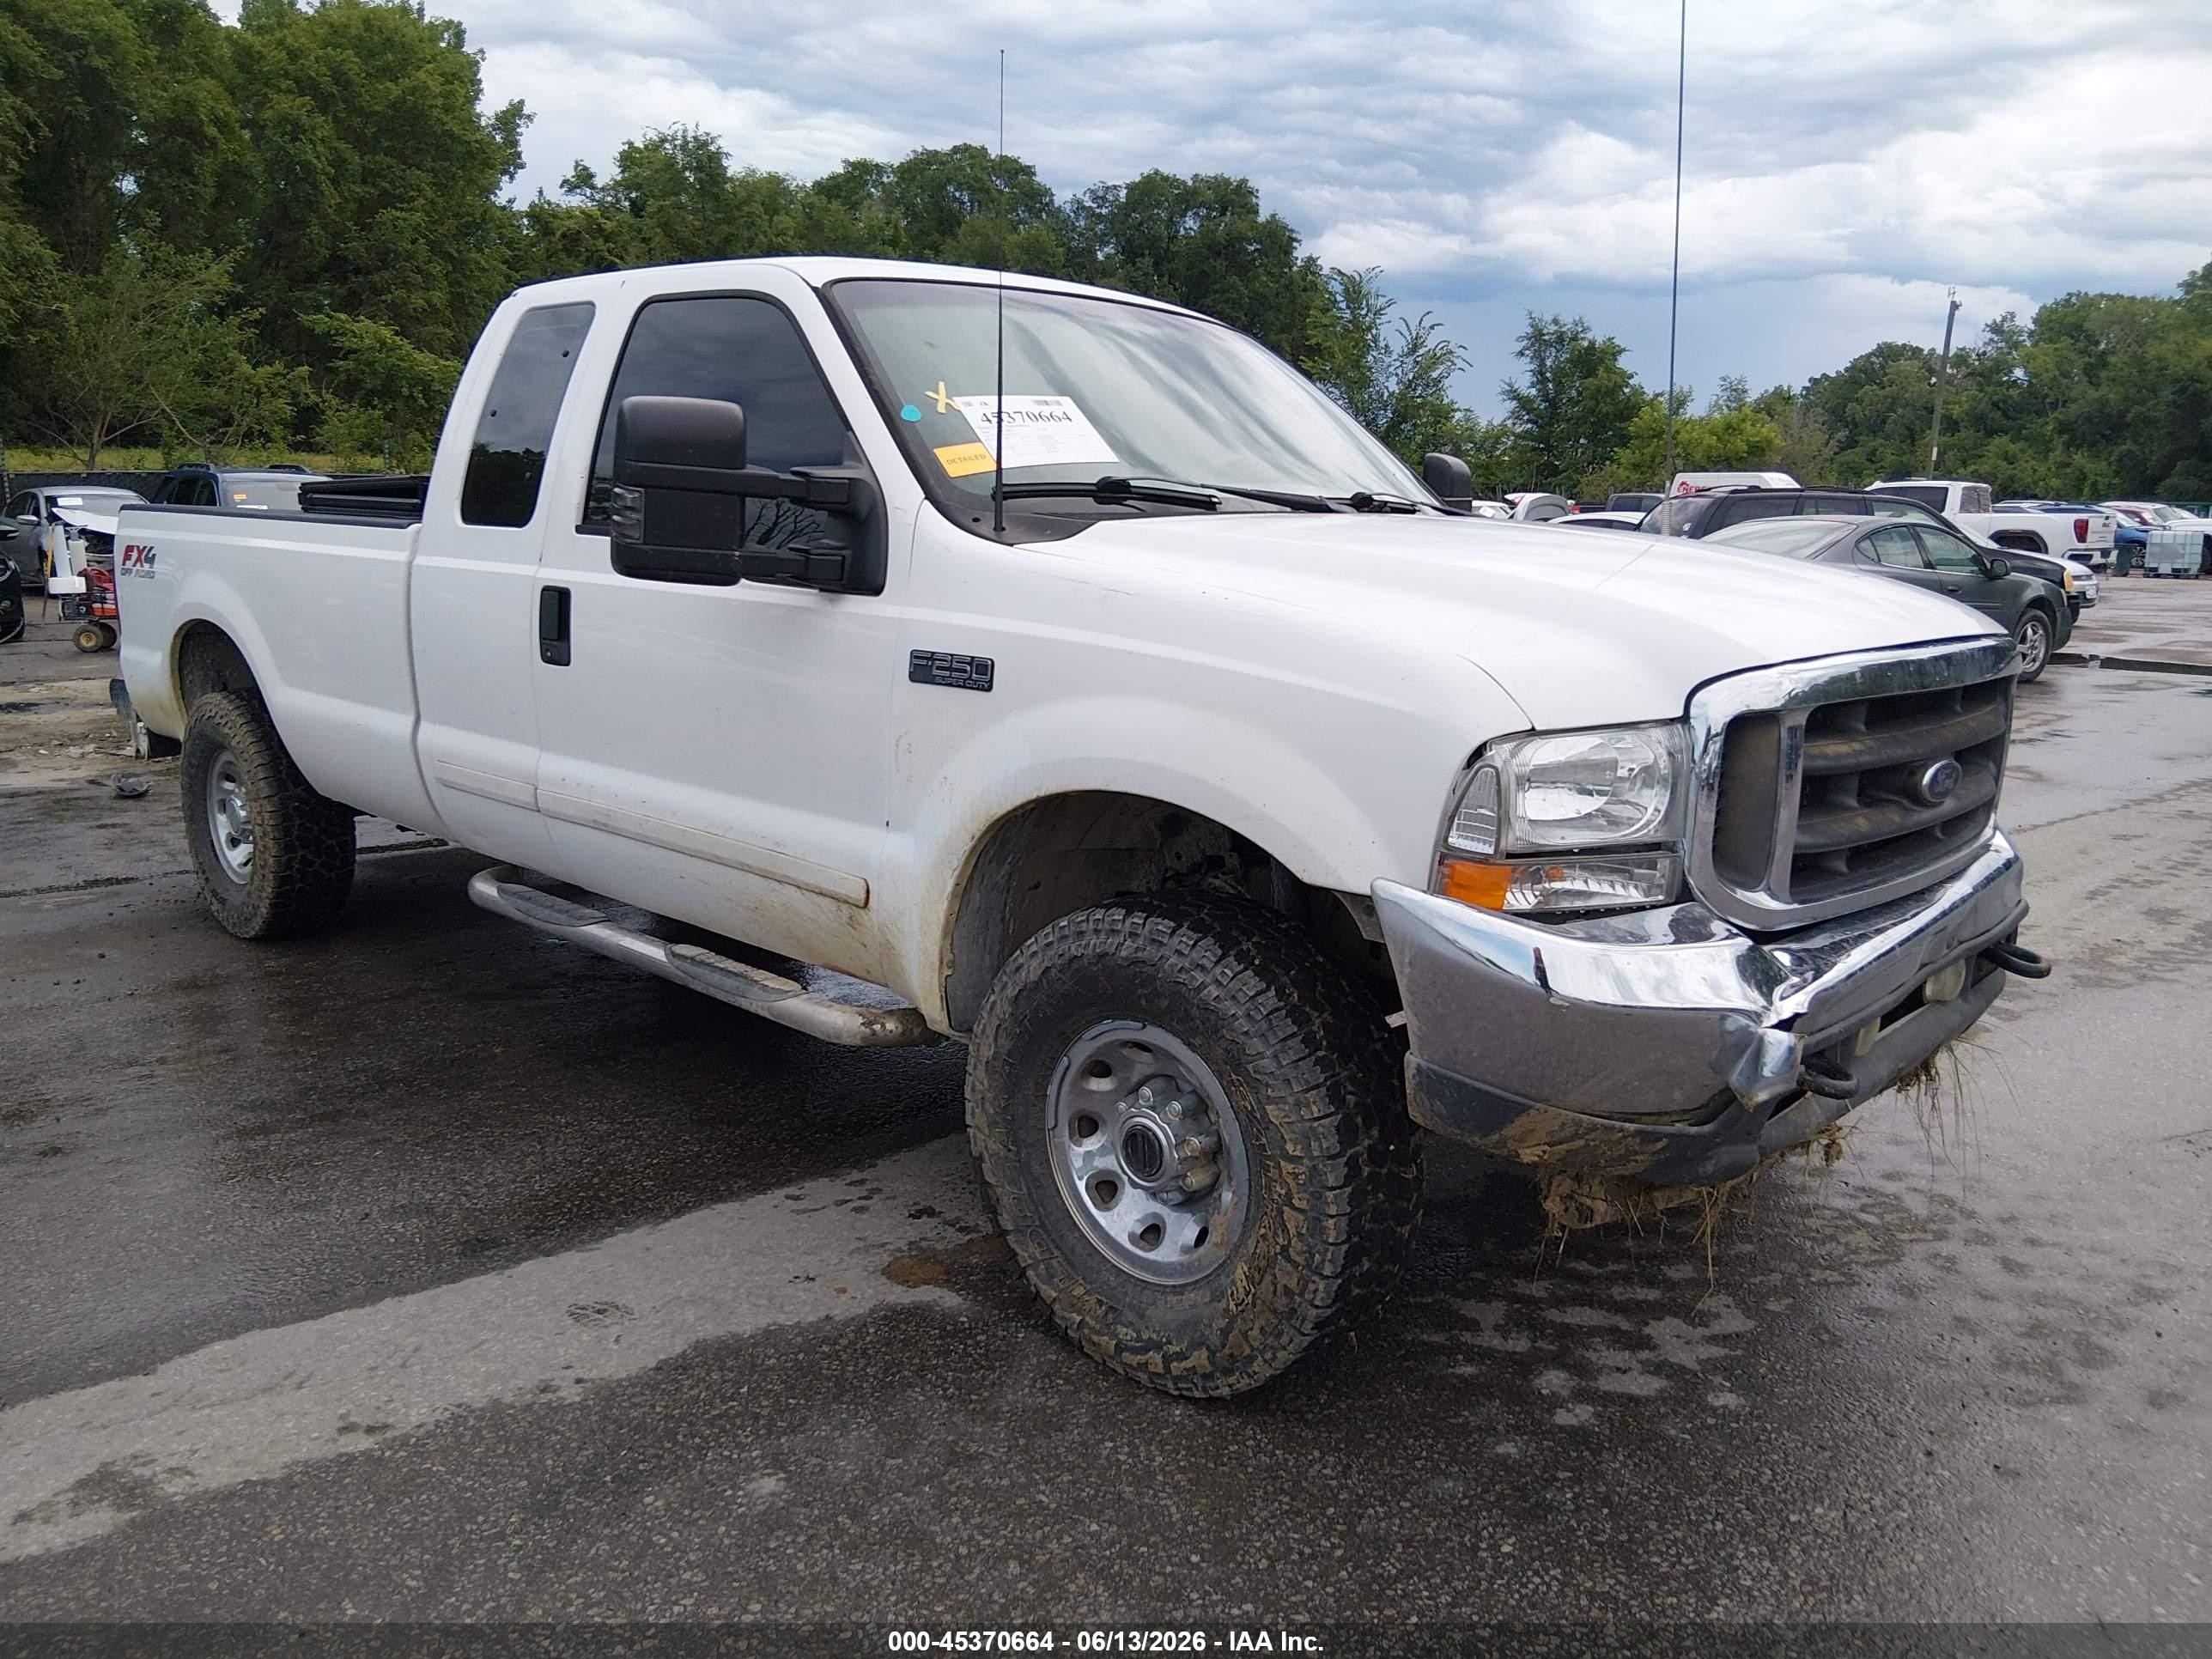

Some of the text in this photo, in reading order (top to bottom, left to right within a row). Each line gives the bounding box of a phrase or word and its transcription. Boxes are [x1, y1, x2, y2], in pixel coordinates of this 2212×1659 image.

[946, 454, 987, 465] DETAILED
[122, 544, 156, 568] FX4
[120, 567, 133, 576] OFF
[910, 651, 993, 682] F-250
[934, 676, 990, 690] SUPER DUTY
